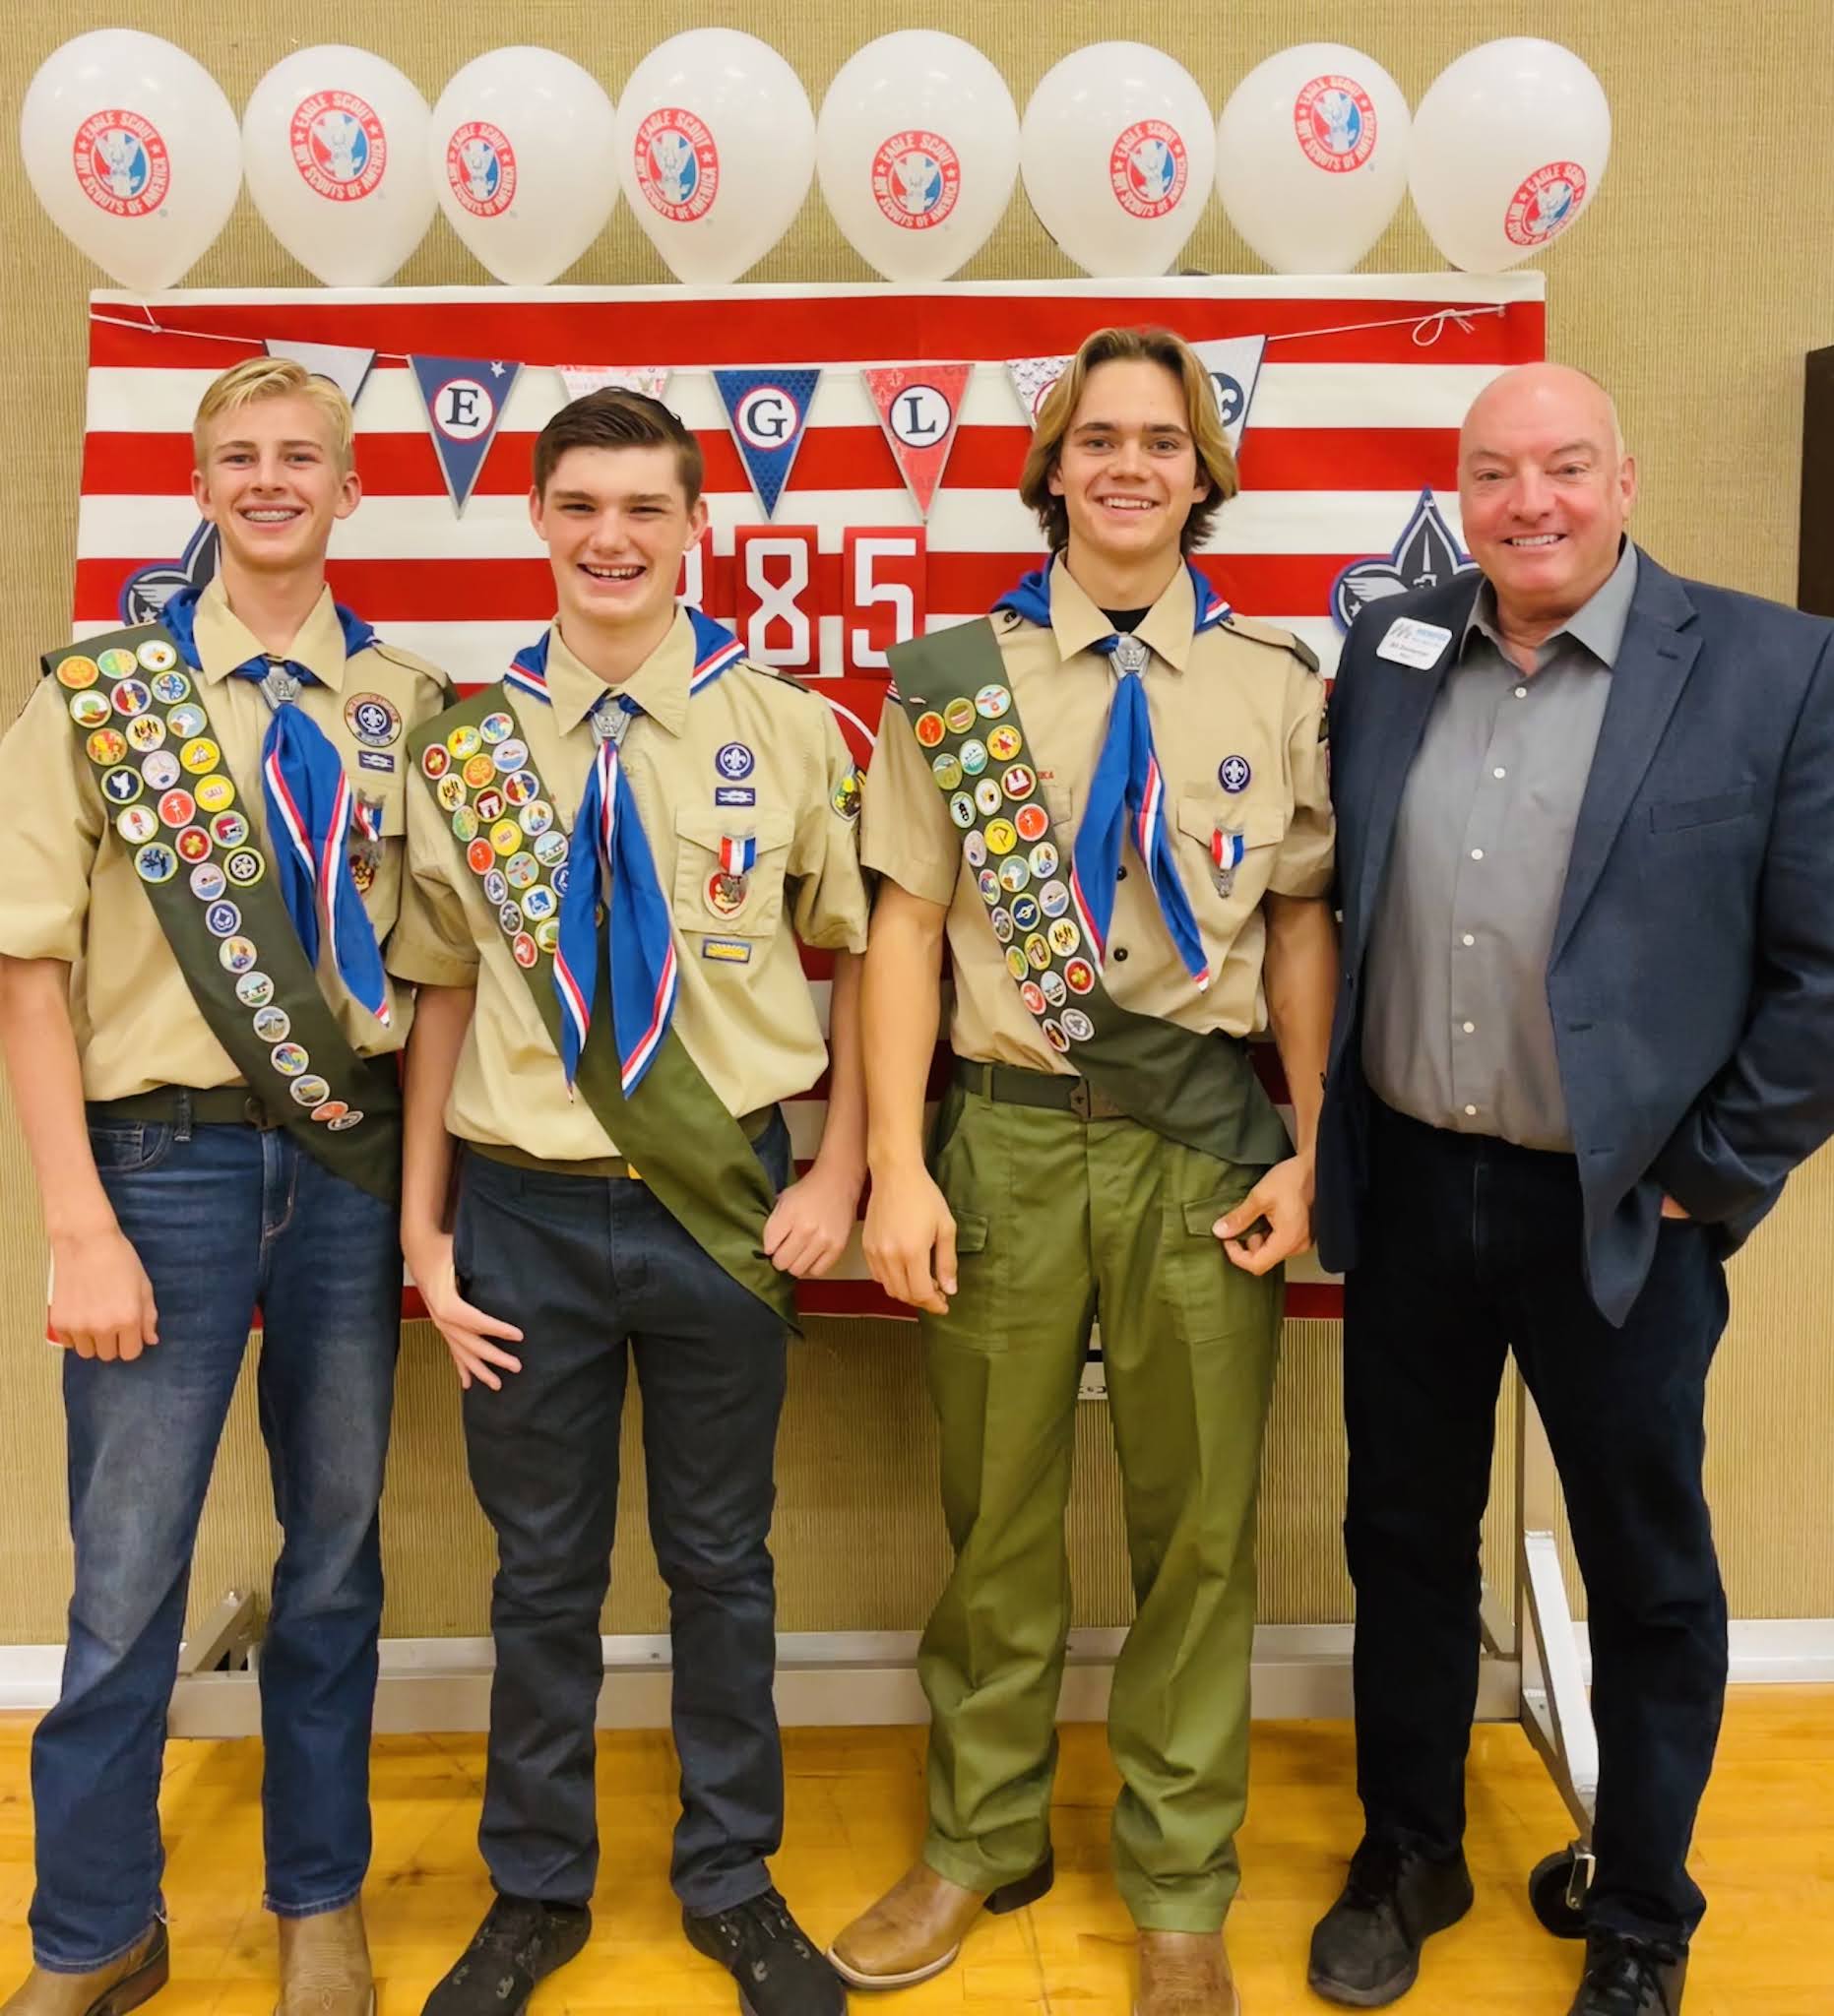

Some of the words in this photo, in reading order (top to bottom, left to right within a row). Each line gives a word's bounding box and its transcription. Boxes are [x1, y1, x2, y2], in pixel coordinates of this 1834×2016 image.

[1298, 79, 1325, 105] EAGLE
[1330, 78, 1364, 98] SCOUT
[81, 112, 116, 141] EAGLE
[119, 113, 158, 142] SCOUT
[294, 94, 329, 127] EAGLE
[333, 93, 374, 122] SCOUT
[640, 110, 670, 143] EAGLE
[675, 111, 711, 148] SCOUT
[1114, 125, 1142, 158] EAGLE
[1147, 122, 1179, 144] SCOUT
[879, 134, 916, 163] EAGLE
[919, 134, 957, 165] SCOUT
[1304, 139, 1341, 171] SCOUTS
[1342, 156, 1356, 168] OF
[82, 176, 125, 214] SCOUTS
[126, 199, 144, 214] OF
[142, 158, 166, 208] AMERICA
[304, 165, 345, 199] SCOUTS
[347, 182, 362, 198] OF
[361, 139, 384, 189] AMERICA
[1525, 164, 1559, 192] EAGLE
[1564, 163, 1585, 188] SCOUT
[676, 205, 692, 220] OF
[689, 167, 717, 216] AMERICA
[879, 196, 914, 226] SCOUTS
[916, 215, 930, 226] OF
[929, 181, 958, 222] AMERICA
[1120, 191, 1156, 217] SCOUTS
[1157, 201, 1170, 214] OF
[445, 387, 479, 427] E
[747, 399, 788, 438] G
[903, 396, 936, 434] L
